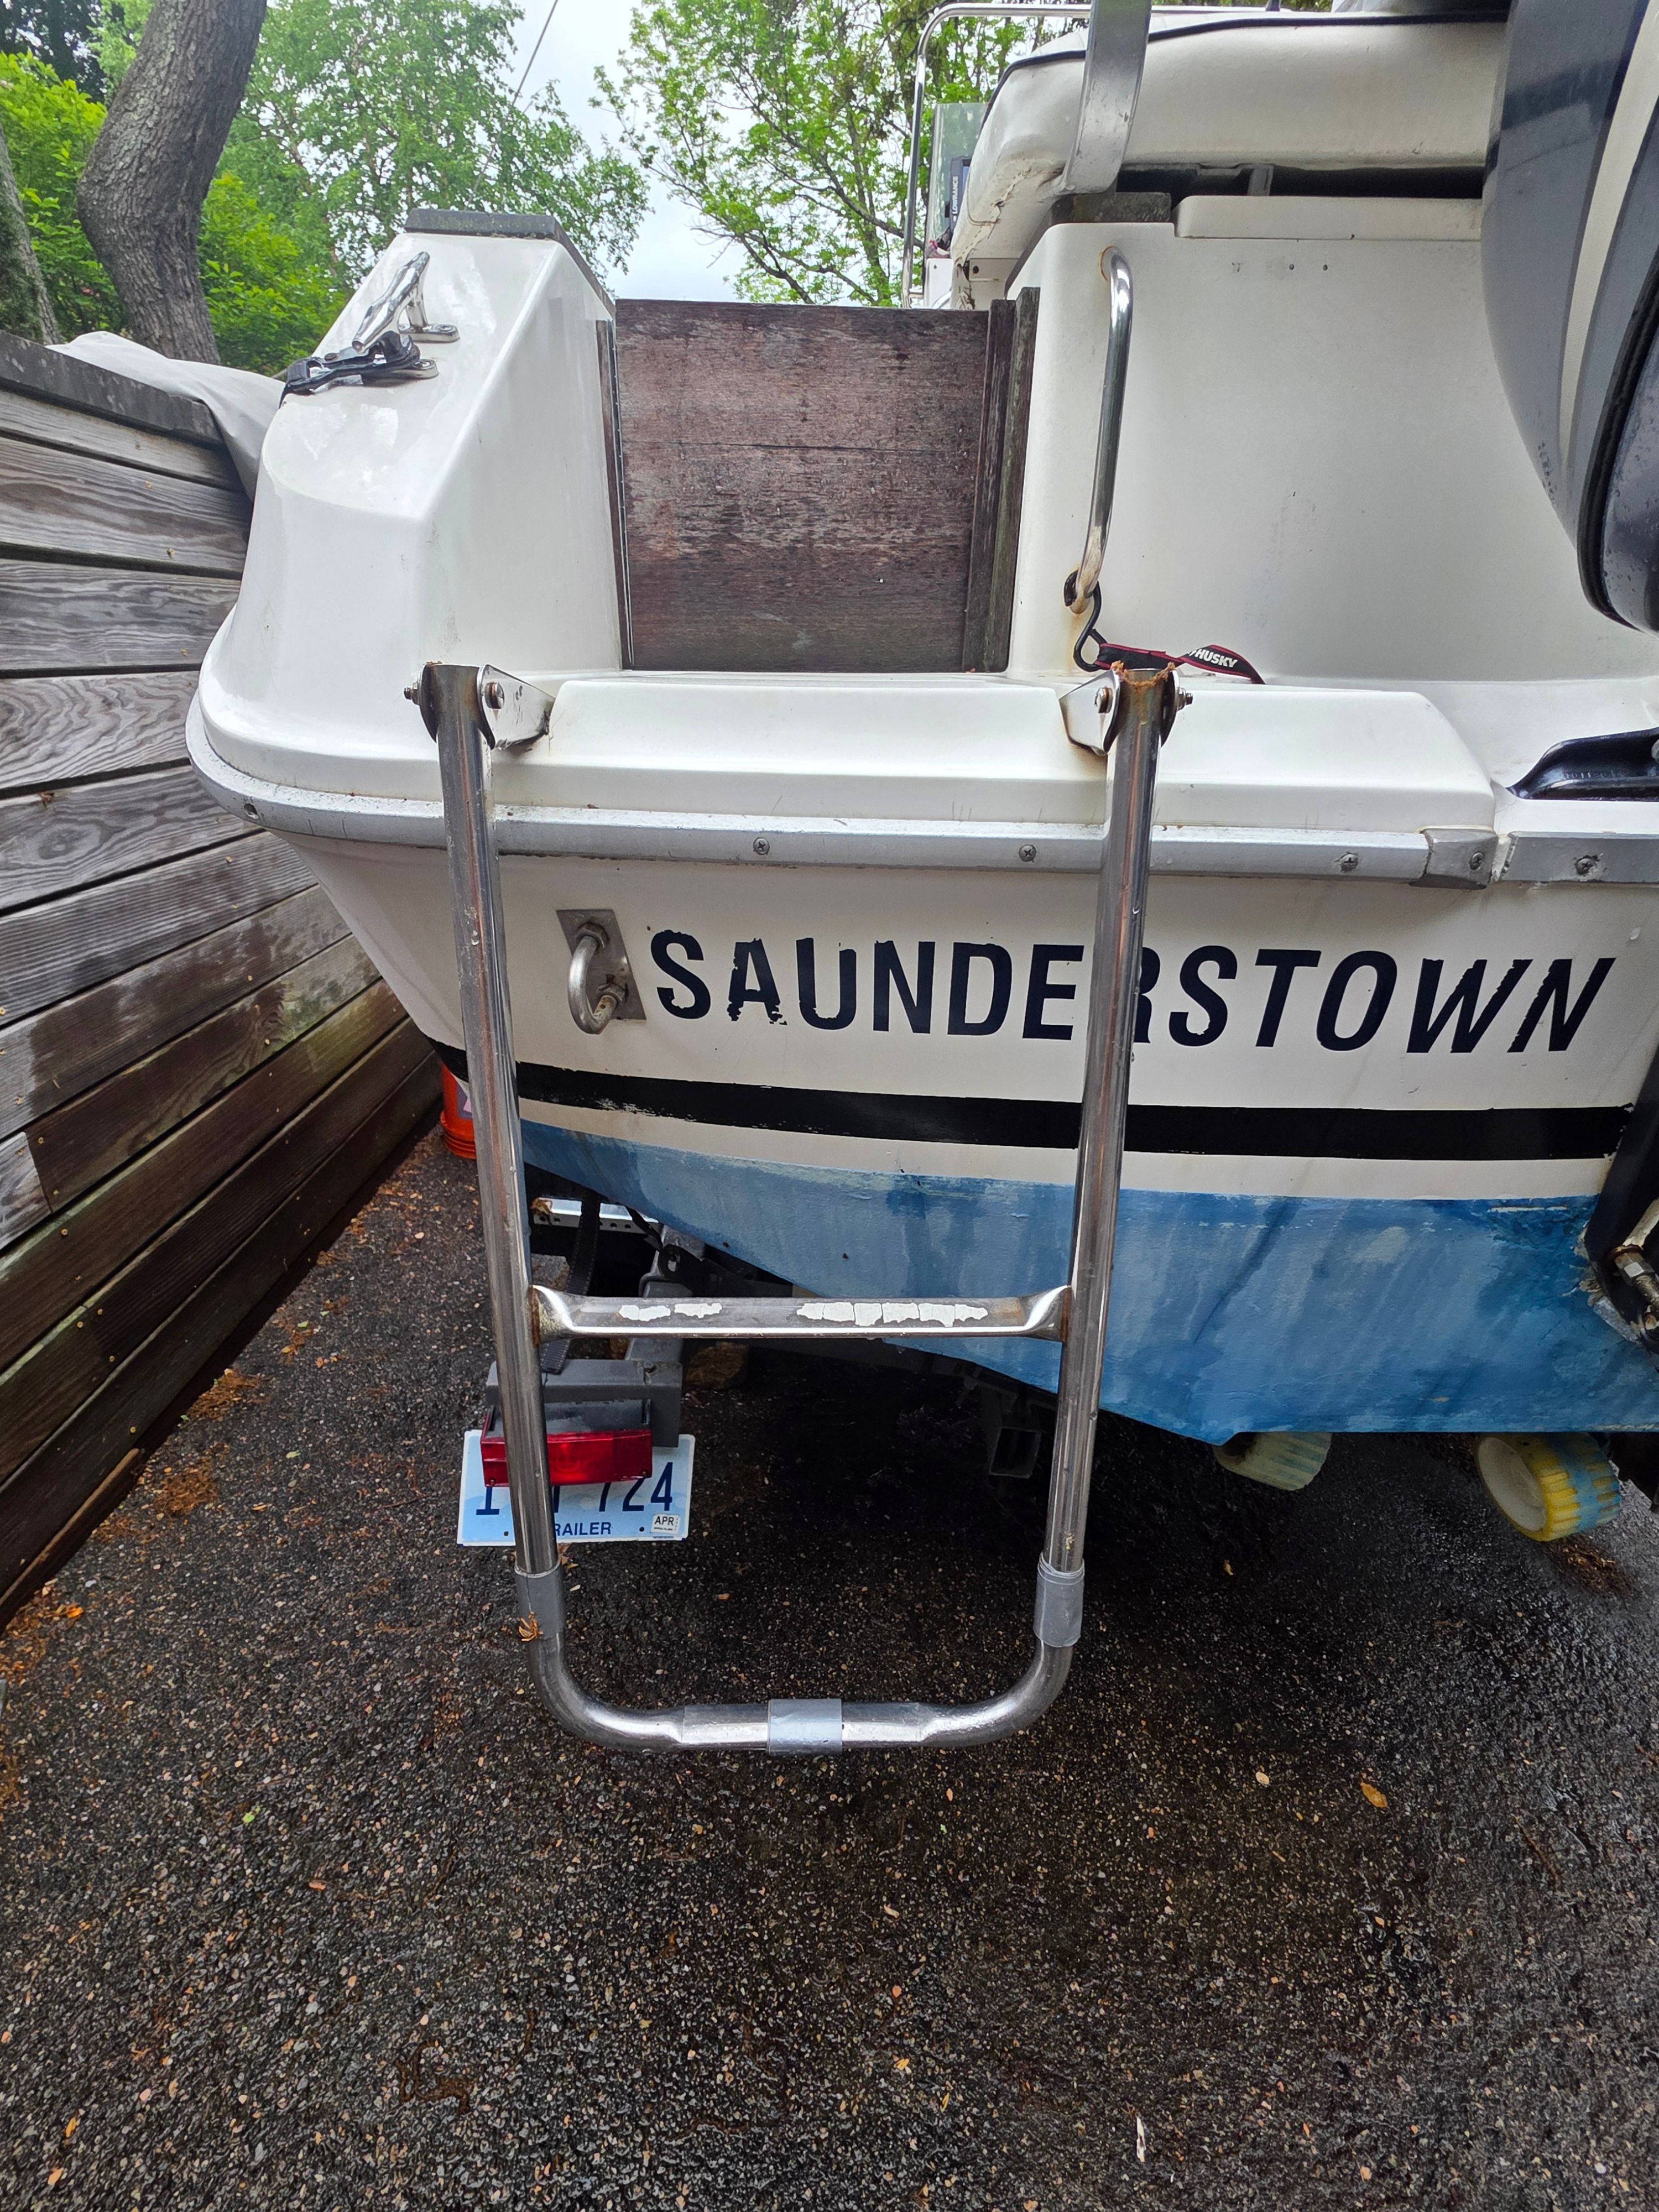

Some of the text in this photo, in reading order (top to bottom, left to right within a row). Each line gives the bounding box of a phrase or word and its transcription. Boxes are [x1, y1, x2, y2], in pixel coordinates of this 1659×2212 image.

[1194, 648, 1238, 668] HUSKY
[654, 1515, 674, 1526] APR
[554, 1522, 612, 1536] RAILER
